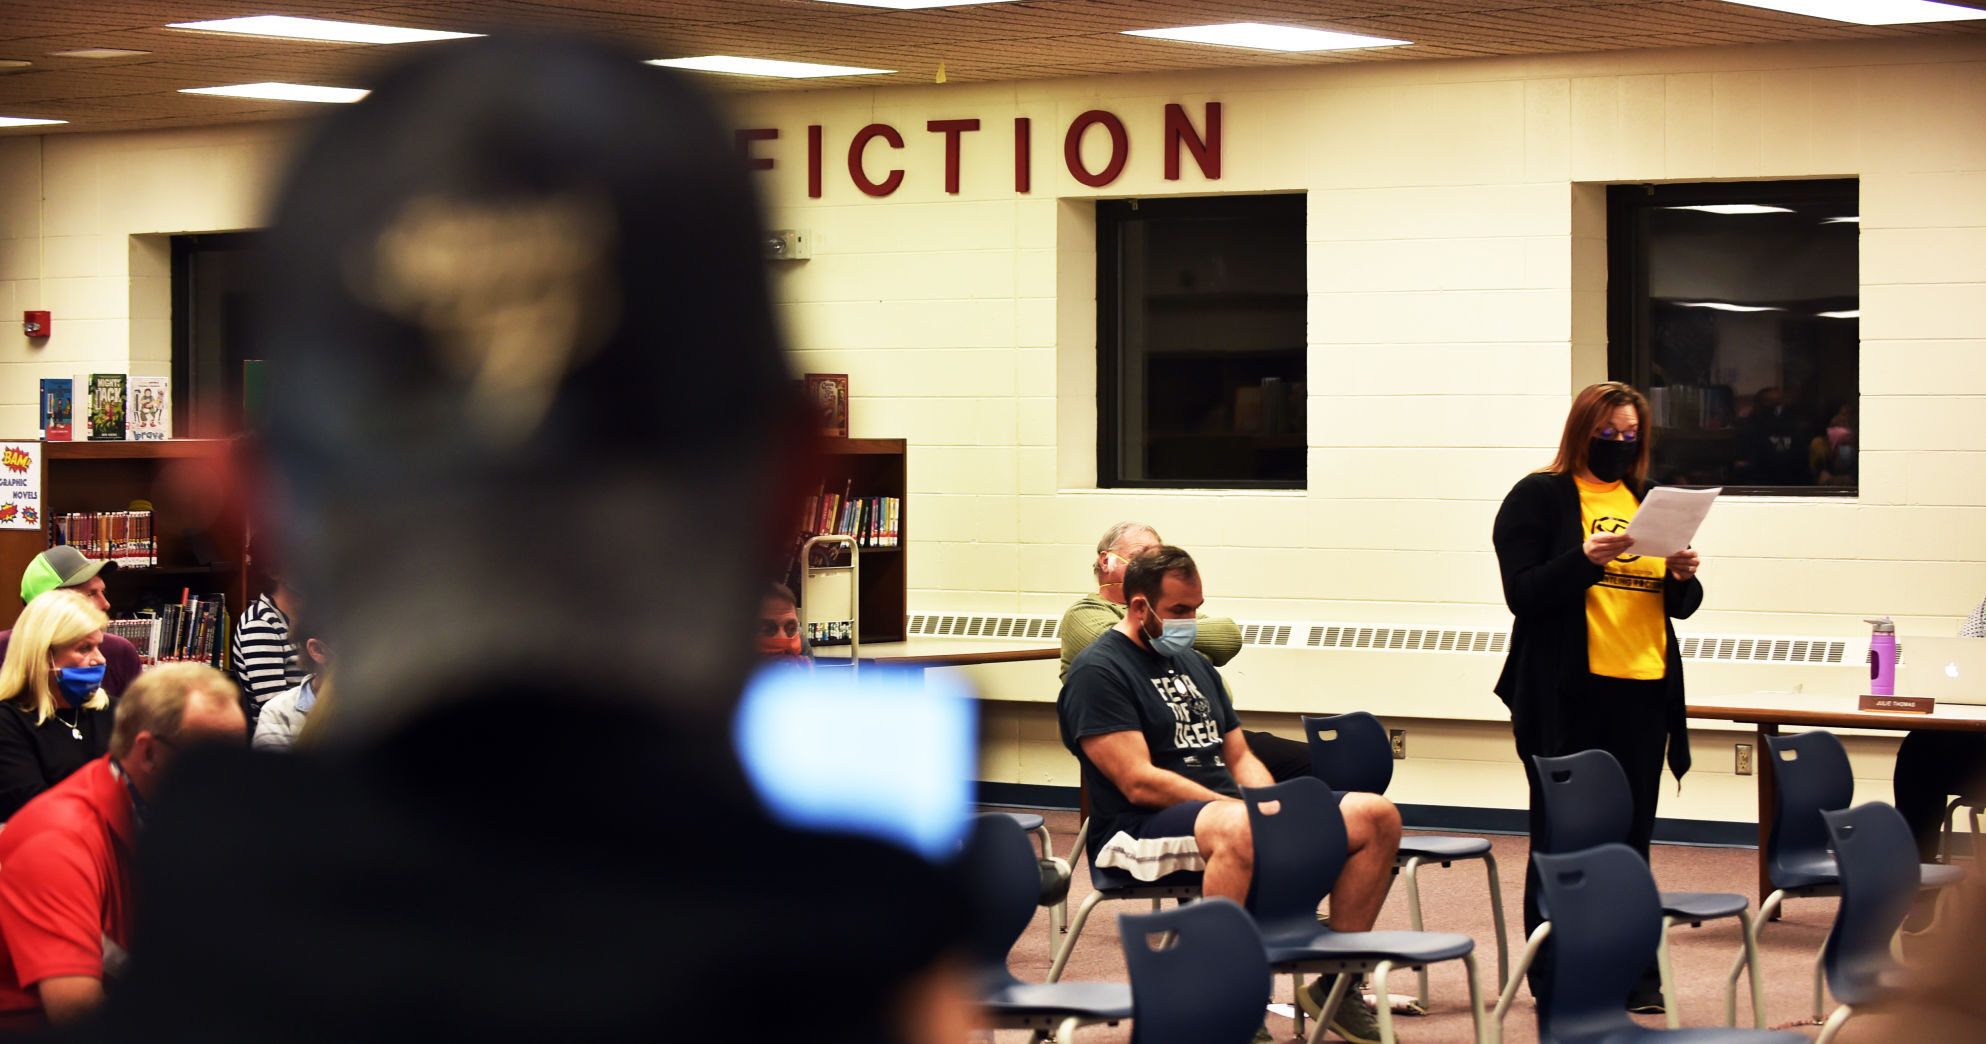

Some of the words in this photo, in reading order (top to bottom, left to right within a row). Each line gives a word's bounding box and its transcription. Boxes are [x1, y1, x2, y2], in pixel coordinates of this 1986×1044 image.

[735, 102, 1222, 198] FICTION
[133, 430, 164, 440] brave
[3, 451, 31, 467] BAM!
[13, 491, 37, 499] NOVELS
[1150, 674, 1206, 702] FER
[1174, 720, 1223, 748] DEER
